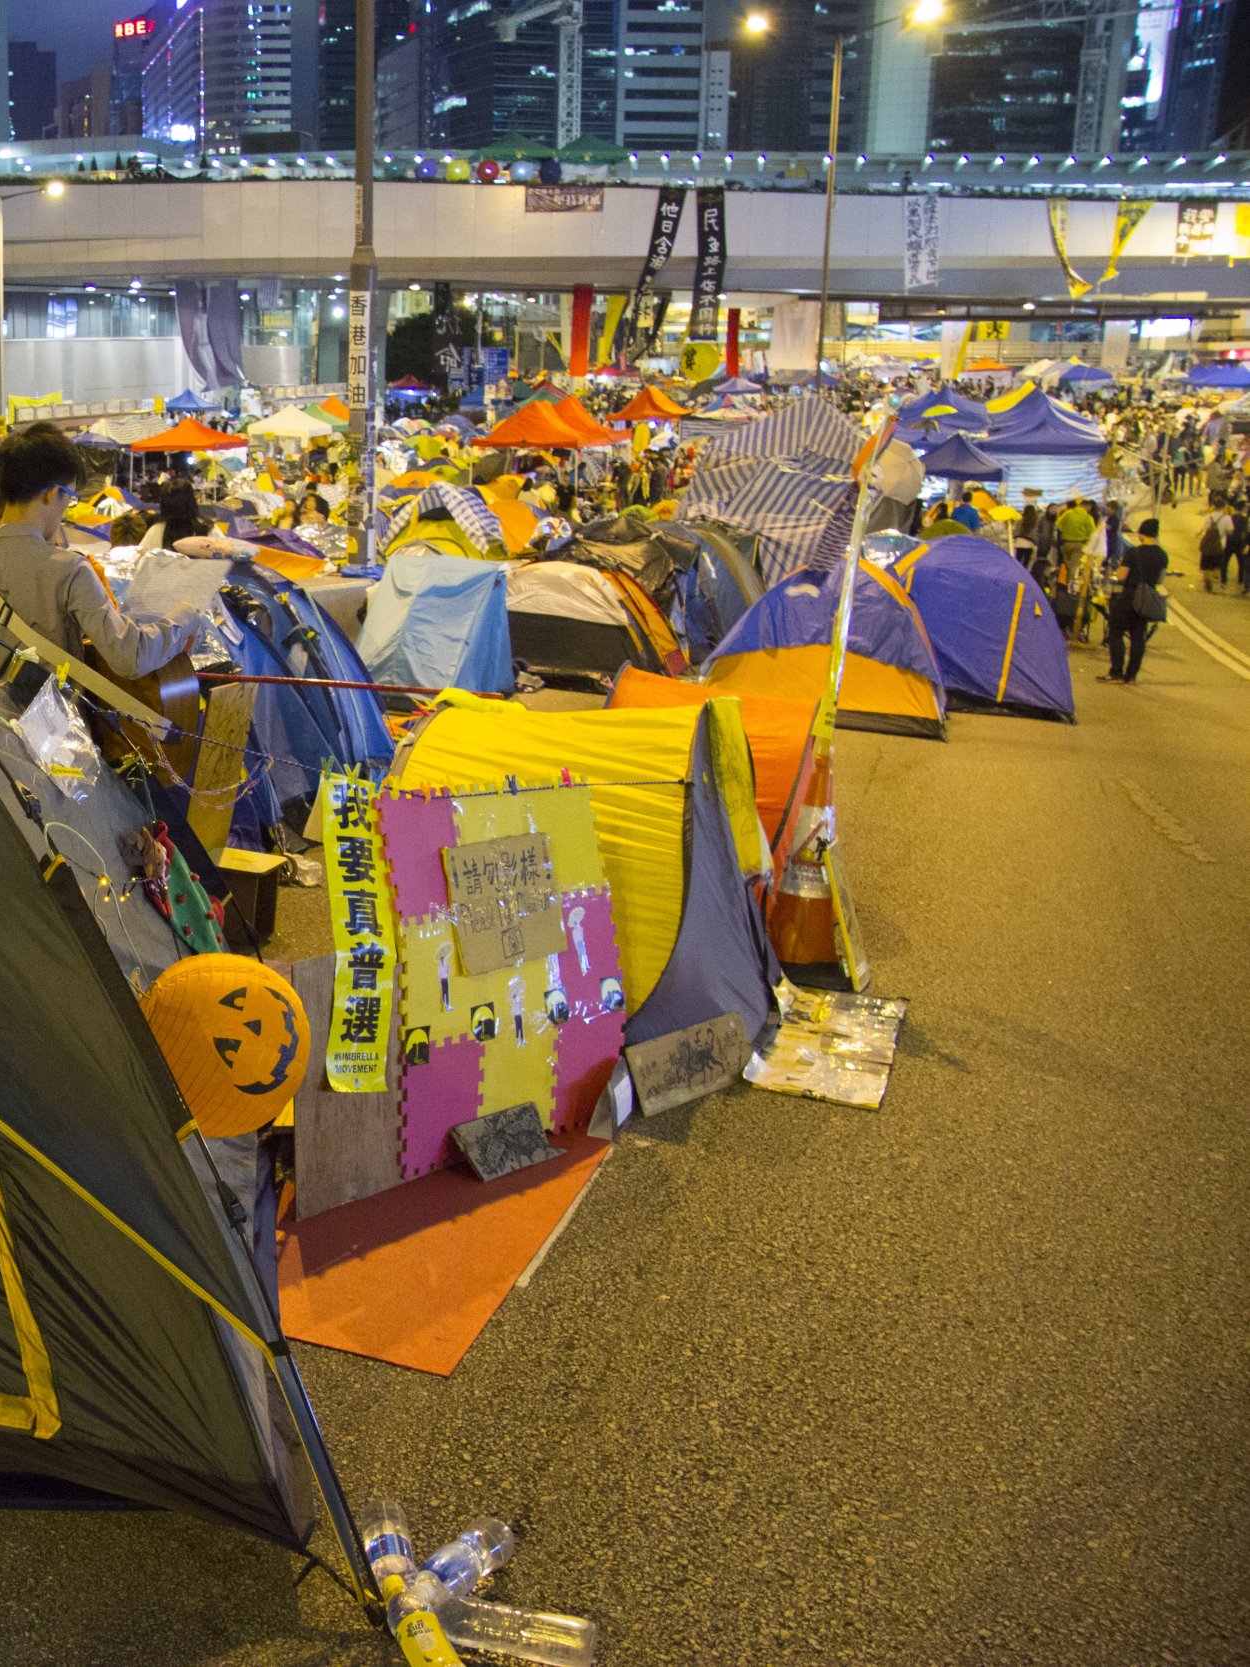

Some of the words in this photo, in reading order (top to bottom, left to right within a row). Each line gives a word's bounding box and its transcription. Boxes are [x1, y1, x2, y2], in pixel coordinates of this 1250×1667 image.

[350, 295, 368, 405] 香港加油
[333, 783, 386, 1044] 我要真普選
[334, 1052, 379, 1061] #UMBRELLA
[335, 1064, 378, 1074] MOVEMENT
